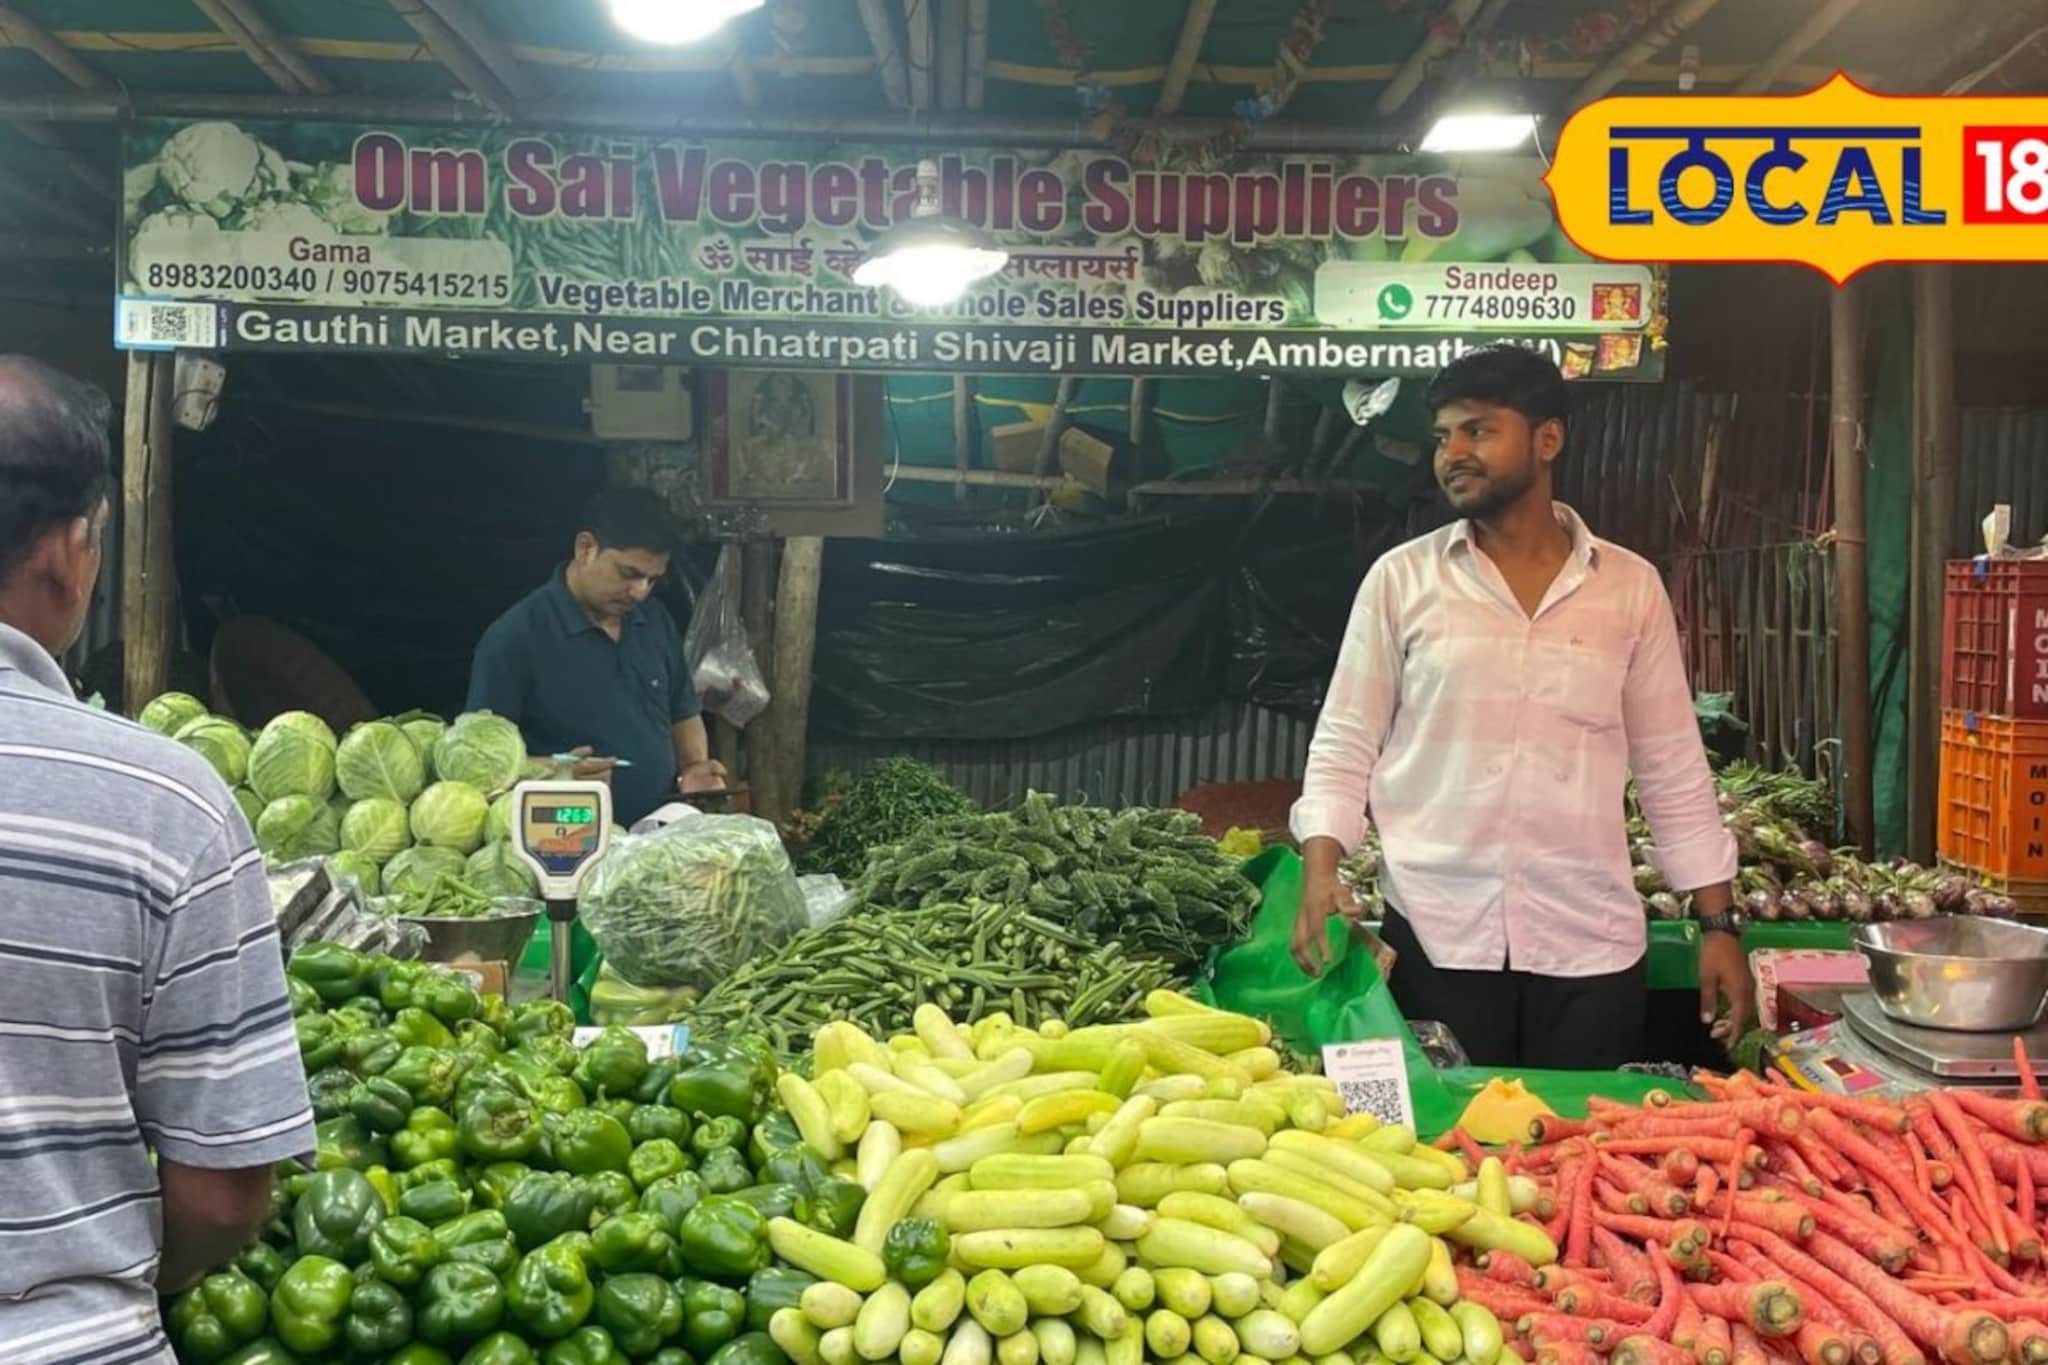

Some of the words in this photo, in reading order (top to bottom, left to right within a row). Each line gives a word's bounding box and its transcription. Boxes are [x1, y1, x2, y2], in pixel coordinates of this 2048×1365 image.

[353, 132, 488, 217] Om
[505, 138, 637, 220] Sai
[1083, 156, 1459, 247] Suppliers
[289, 237, 371, 264] Gama
[746, 239, 813, 275] साई
[148, 263, 316, 292] 8983200340
[326, 268, 335, 293] /
[344, 269, 508, 298] 9075415215
[1445, 265, 1557, 294] Sandeep
[539, 276, 711, 313] Vegetable
[723, 280, 878, 314] Merchant
[1037, 292, 1125, 319] Sales
[1136, 293, 1286, 326] Suppliers
[1425, 295, 1576, 320] 7774809630
[236, 309, 388, 346] Gauthi
[691, 325, 918, 367] Chhatrpati
[933, 331, 1075, 371] Shivaji
